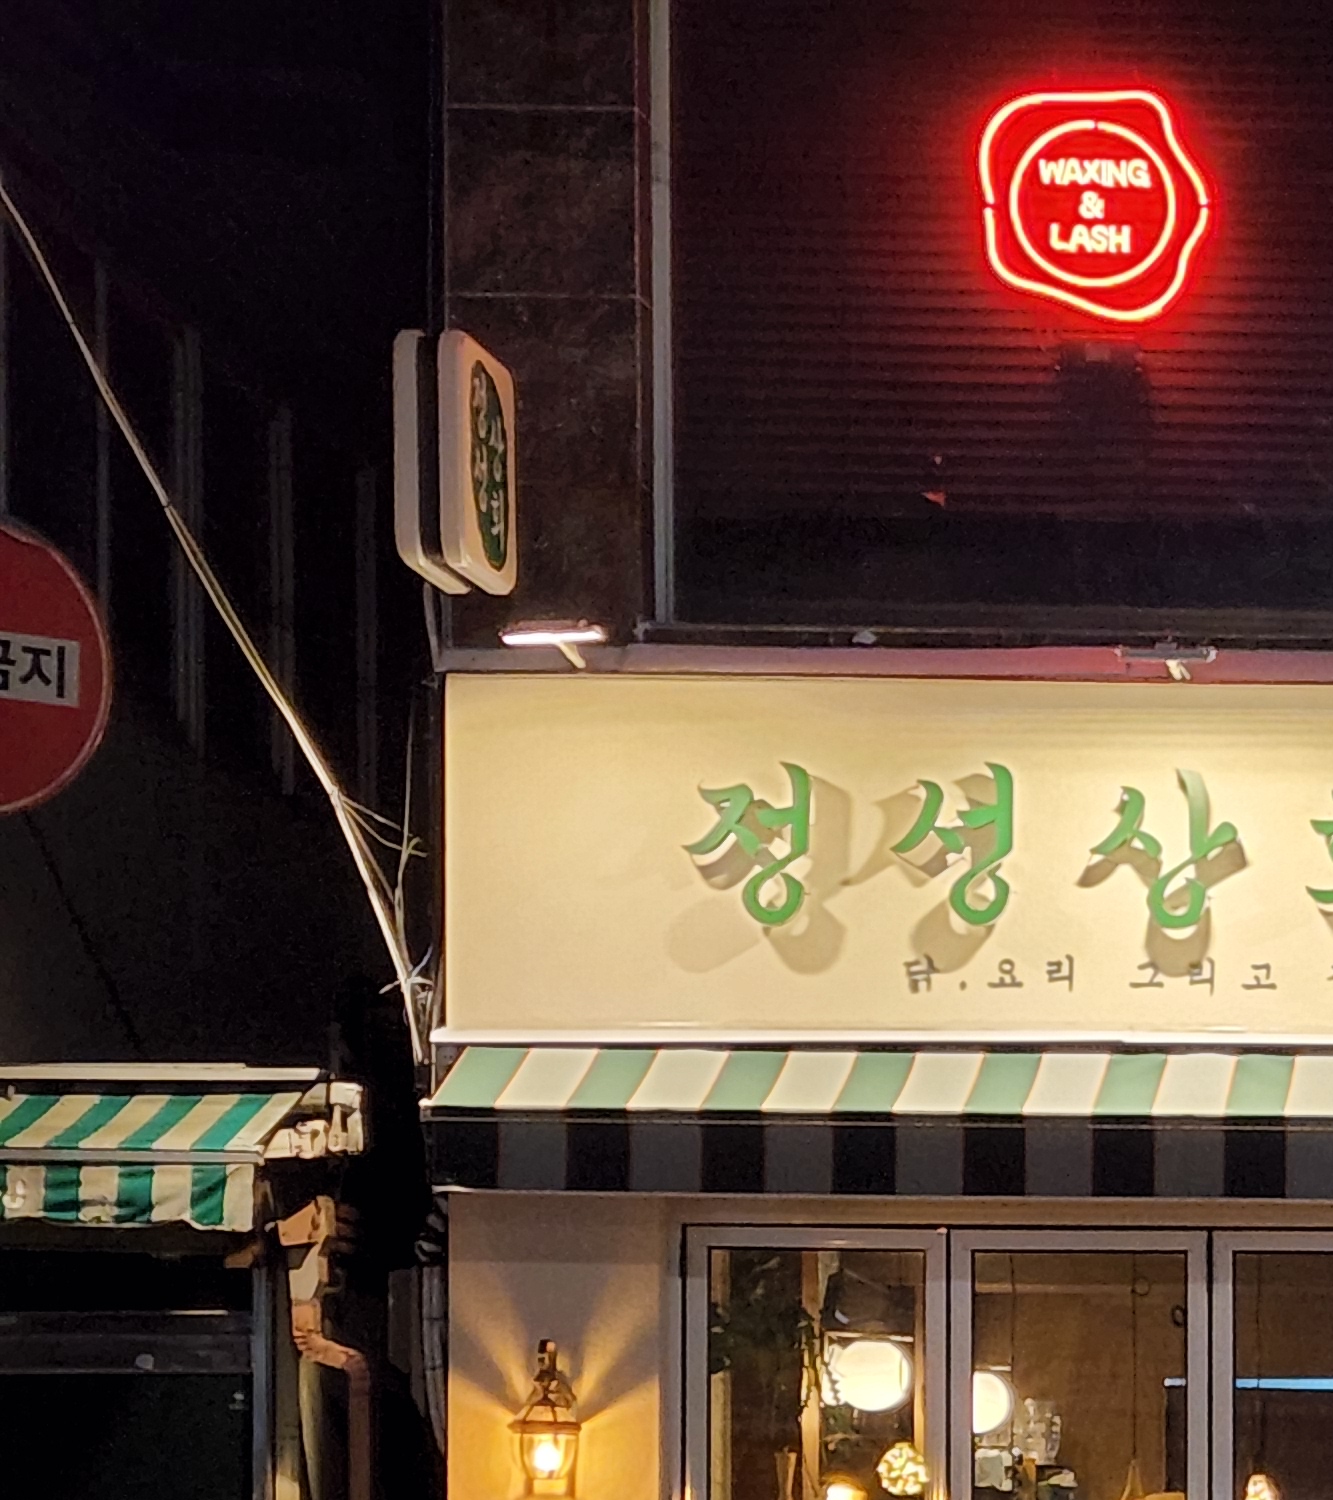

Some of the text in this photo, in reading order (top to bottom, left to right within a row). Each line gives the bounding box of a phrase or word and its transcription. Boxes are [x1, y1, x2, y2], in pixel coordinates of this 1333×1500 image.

[1038, 158, 1152, 188] WAXING
[1078, 191, 1105, 219] &
[1049, 223, 1131, 253] LASH
[1128, 955, 1278, 996] 그리고
